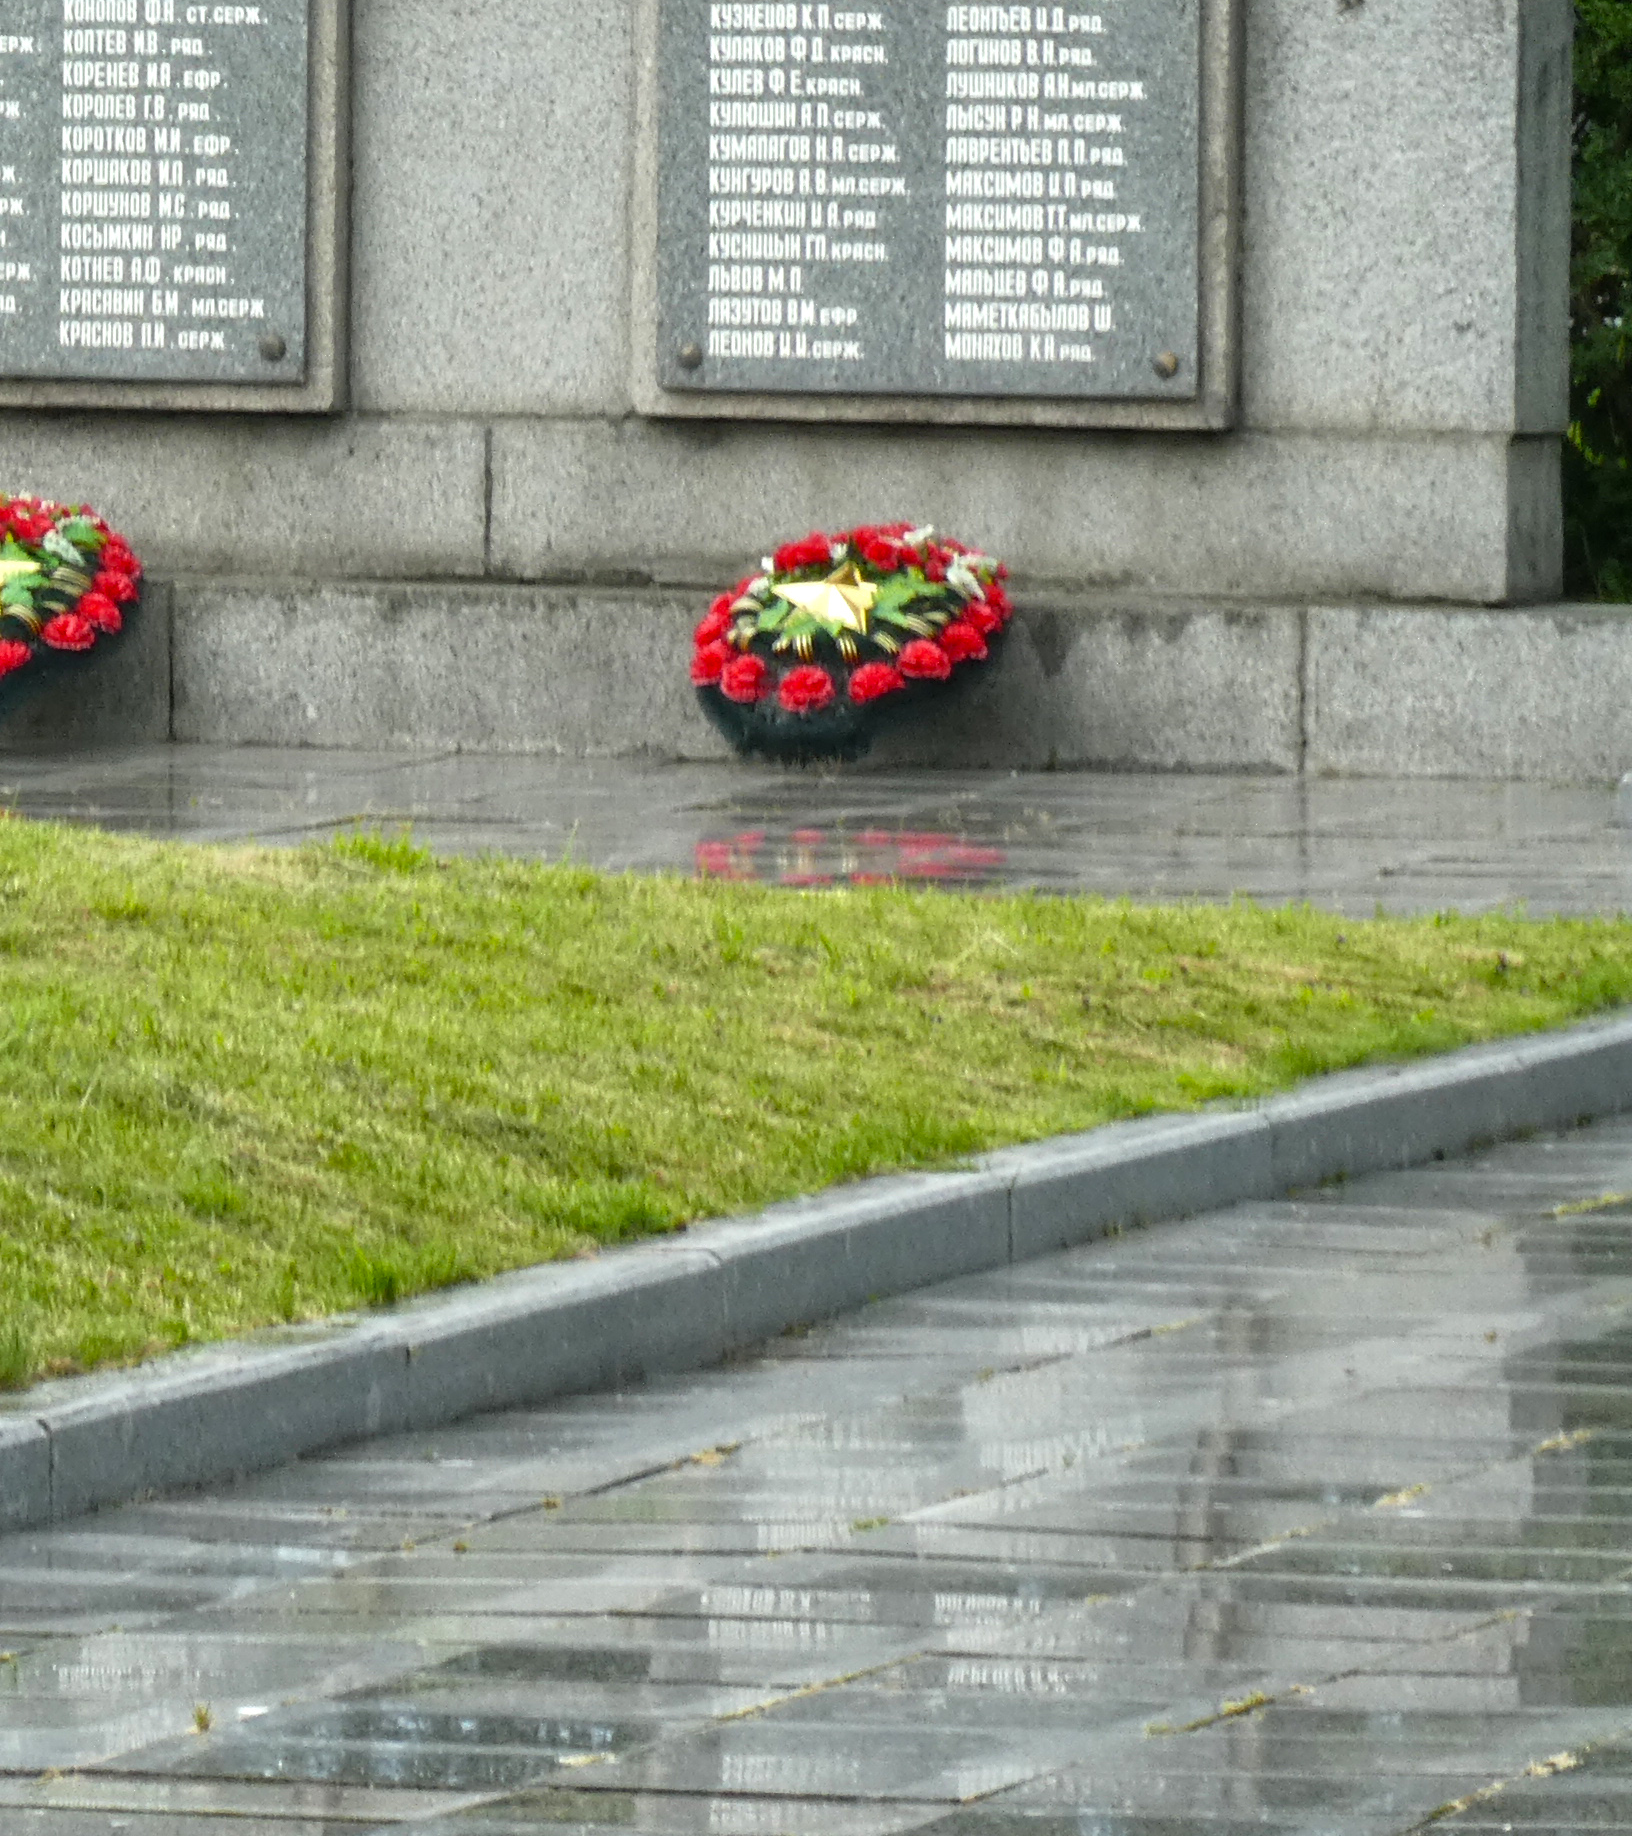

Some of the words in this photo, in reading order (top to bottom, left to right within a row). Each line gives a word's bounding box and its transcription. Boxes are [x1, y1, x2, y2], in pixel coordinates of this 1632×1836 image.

[946, 4, 1032, 32] ЛЕОНТЬЕВ
[709, 35, 786, 61] КУЛАКОВ
[946, 38, 1022, 64] ЛОГИНОВ
[62, 60, 140, 87] КОРЕНЕВ
[709, 67, 765, 94] КУЛЕВ
[946, 71, 1040, 99] ЛУШНИКОВ
[62, 93, 137, 119] КОРОЛЕВ
[945, 104, 1007, 130] ЛЫСУН
[61, 125, 147, 152] КОРОТКОВ
[945, 136, 1053, 164] ЛАВРЕНТЬЕВ
[61, 158, 152, 185] КОРШАКОВ
[708, 166, 795, 194] КУНГУРОВ
[61, 190, 151, 217] КОРШУНОВ
[709, 199, 807, 227] КУРЧЕНКИН
[945, 203, 1044, 230] МАКСИМОВ
[708, 265, 764, 291] ЛЬВОВ
[59, 320, 134, 347] КРАСНОВ
